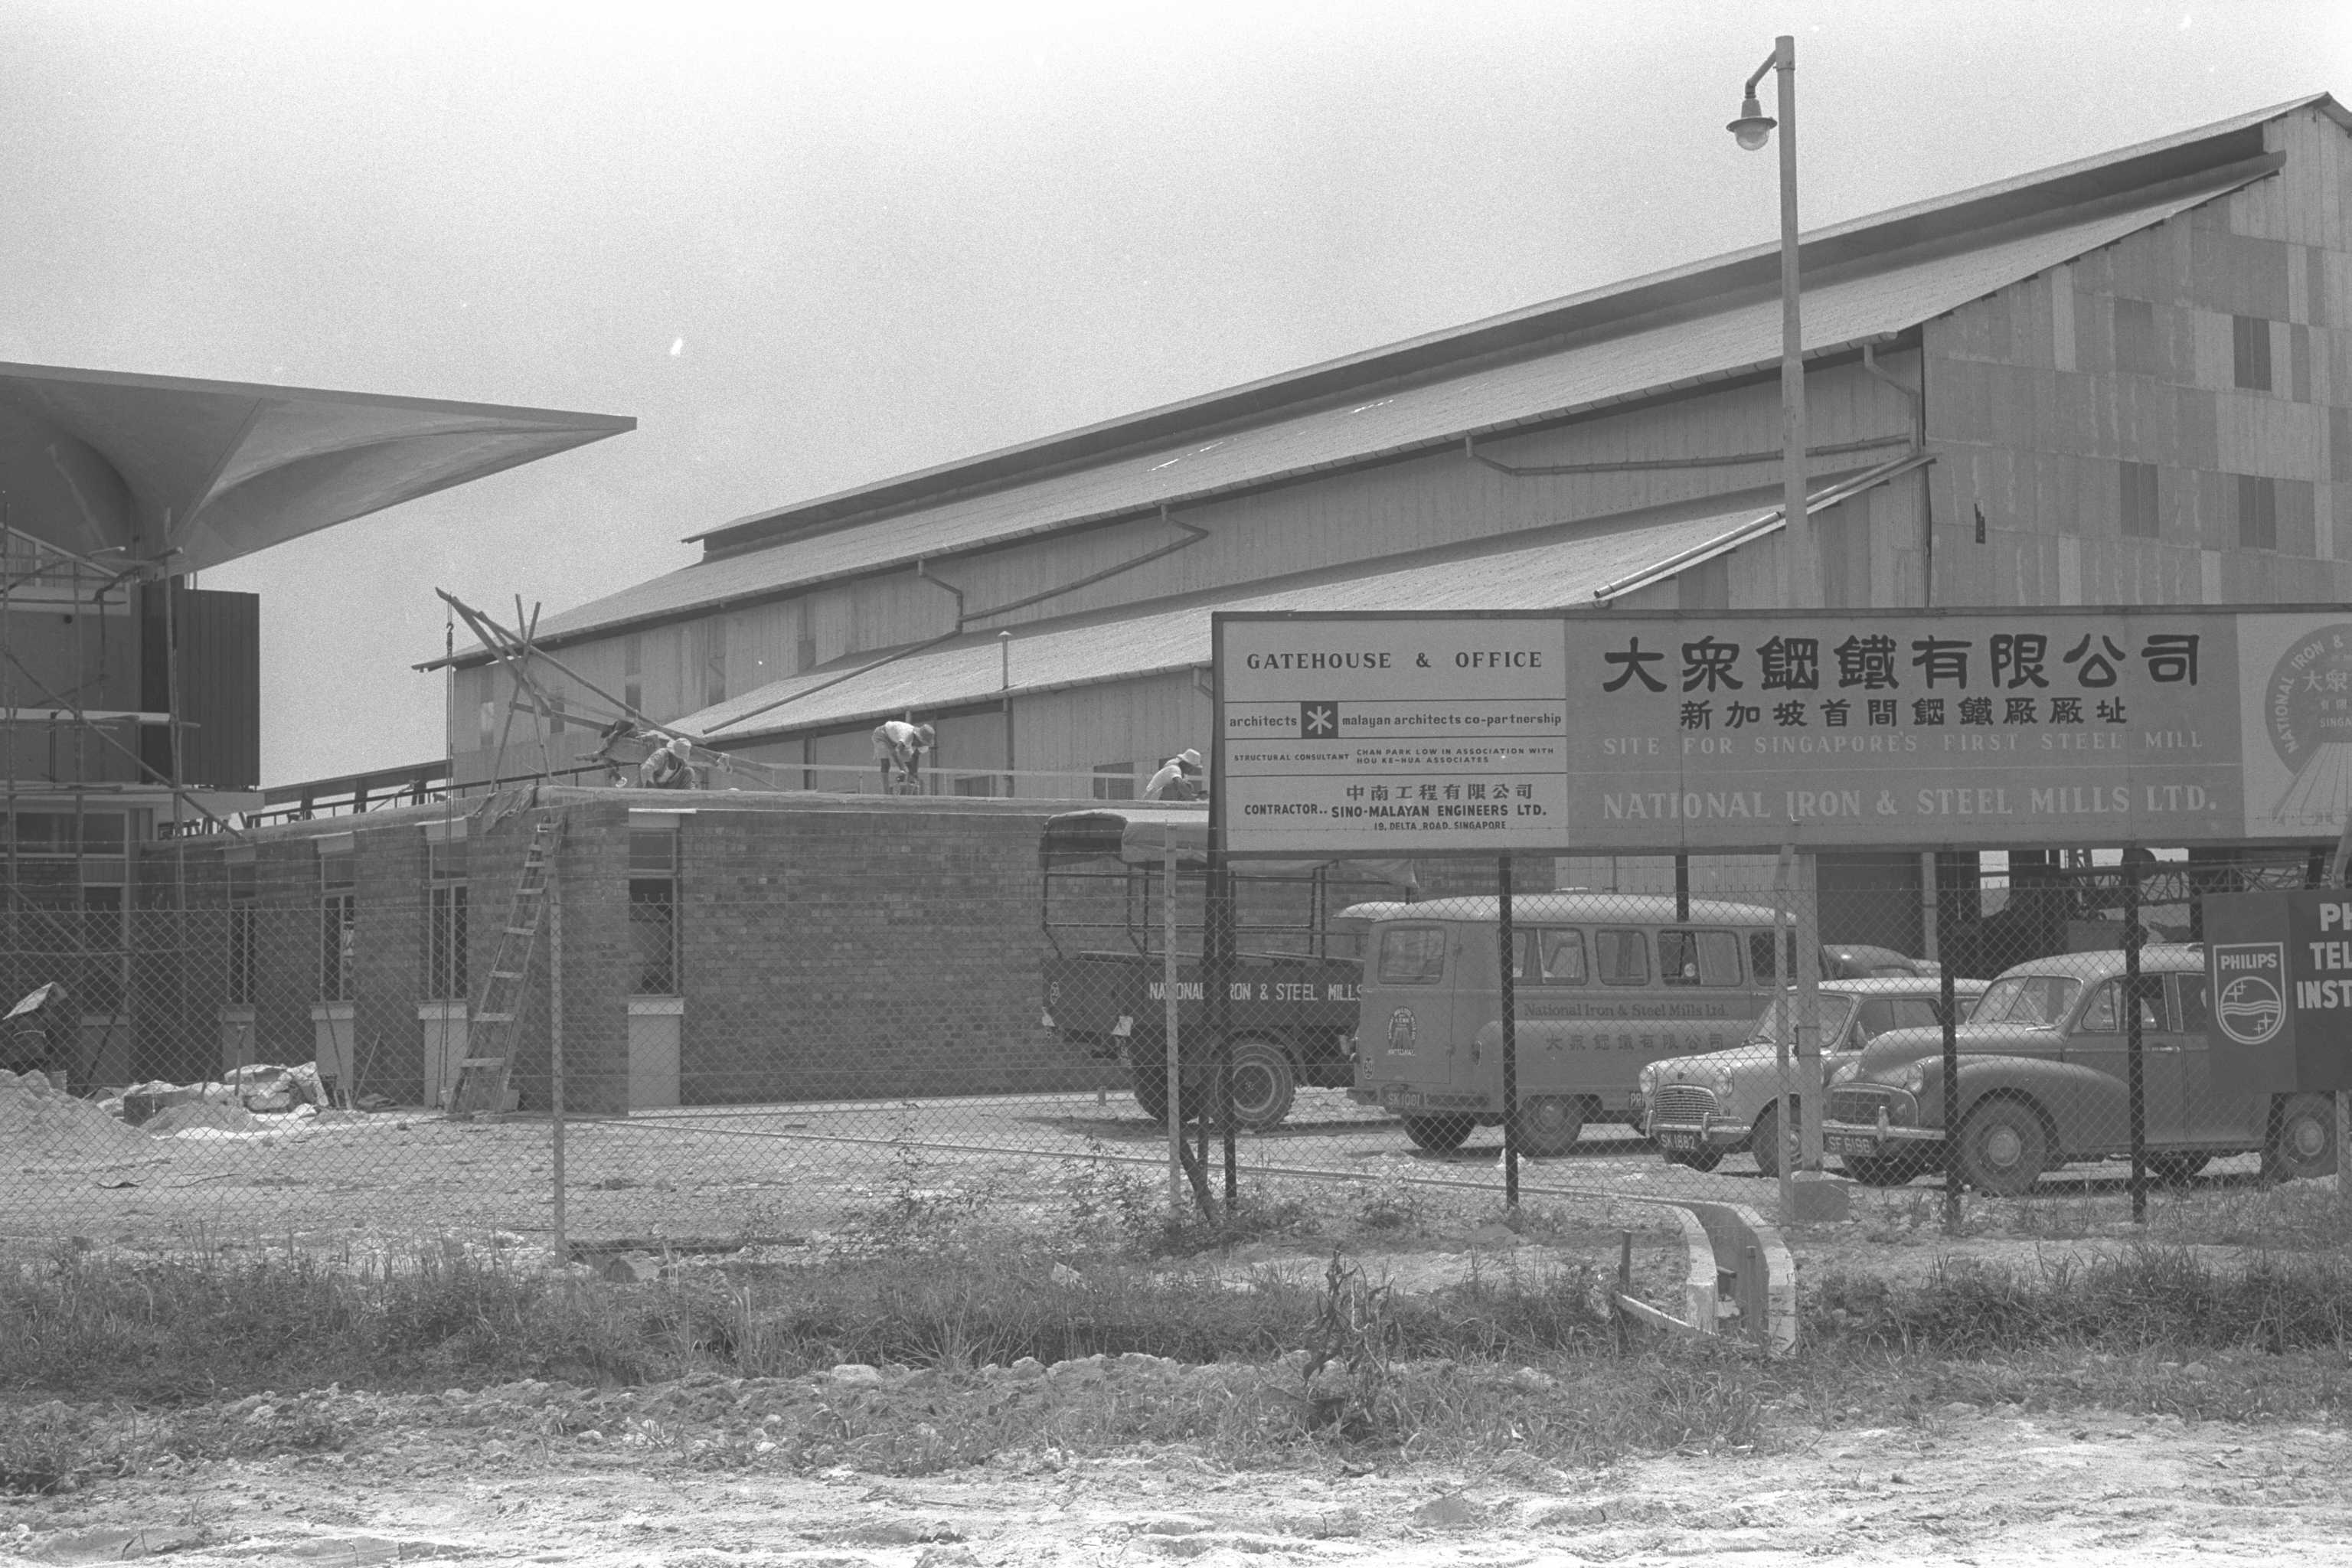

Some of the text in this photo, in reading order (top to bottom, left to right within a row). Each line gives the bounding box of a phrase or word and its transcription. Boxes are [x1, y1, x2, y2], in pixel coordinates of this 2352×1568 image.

[1246, 651, 1543, 670] GATEHOUSE & OFFICE
[2275, 677, 2299, 753] NATIONAL
[2291, 640, 2324, 670] IRON
[2334, 635, 2344, 648] &
[1229, 714, 1298, 727] architects
[1342, 713, 1562, 728] malayan architects co-partnership
[1603, 730, 2203, 755] SITE FOR SINGAPORE'S FIRST STEEL MILL
[1234, 753, 1350, 762] STRUCTURAL CONSULTANT
[1346, 783, 1533, 801] 中南工程有限公司
[1331, 804, 1547, 818] SINO-MALAYAN ENGINEERS LTD.
[1603, 785, 2217, 819] NATIONAL IRON & STEEL MILLS LTD.
[1390, 822, 1417, 831] DELTA
[1454, 821, 1506, 830] SINGAPORE
[2220, 953, 2278, 970] PHILIPS
[2309, 941, 2352, 970] TEL
[1149, 982, 1204, 1000] NAONAL
[1230, 982, 1251, 1000] RON
[1260, 983, 1269, 1000] &
[1276, 983, 1318, 1001] STEEL
[2297, 979, 2352, 1009] INST
[1524, 1004, 1582, 1017] National
[1586, 1004, 1615, 1017] Iron
[1617, 1004, 1628, 1017] &
[1632, 1004, 1666, 1017] Steel
[1669, 1004, 1703, 1017] Mills
